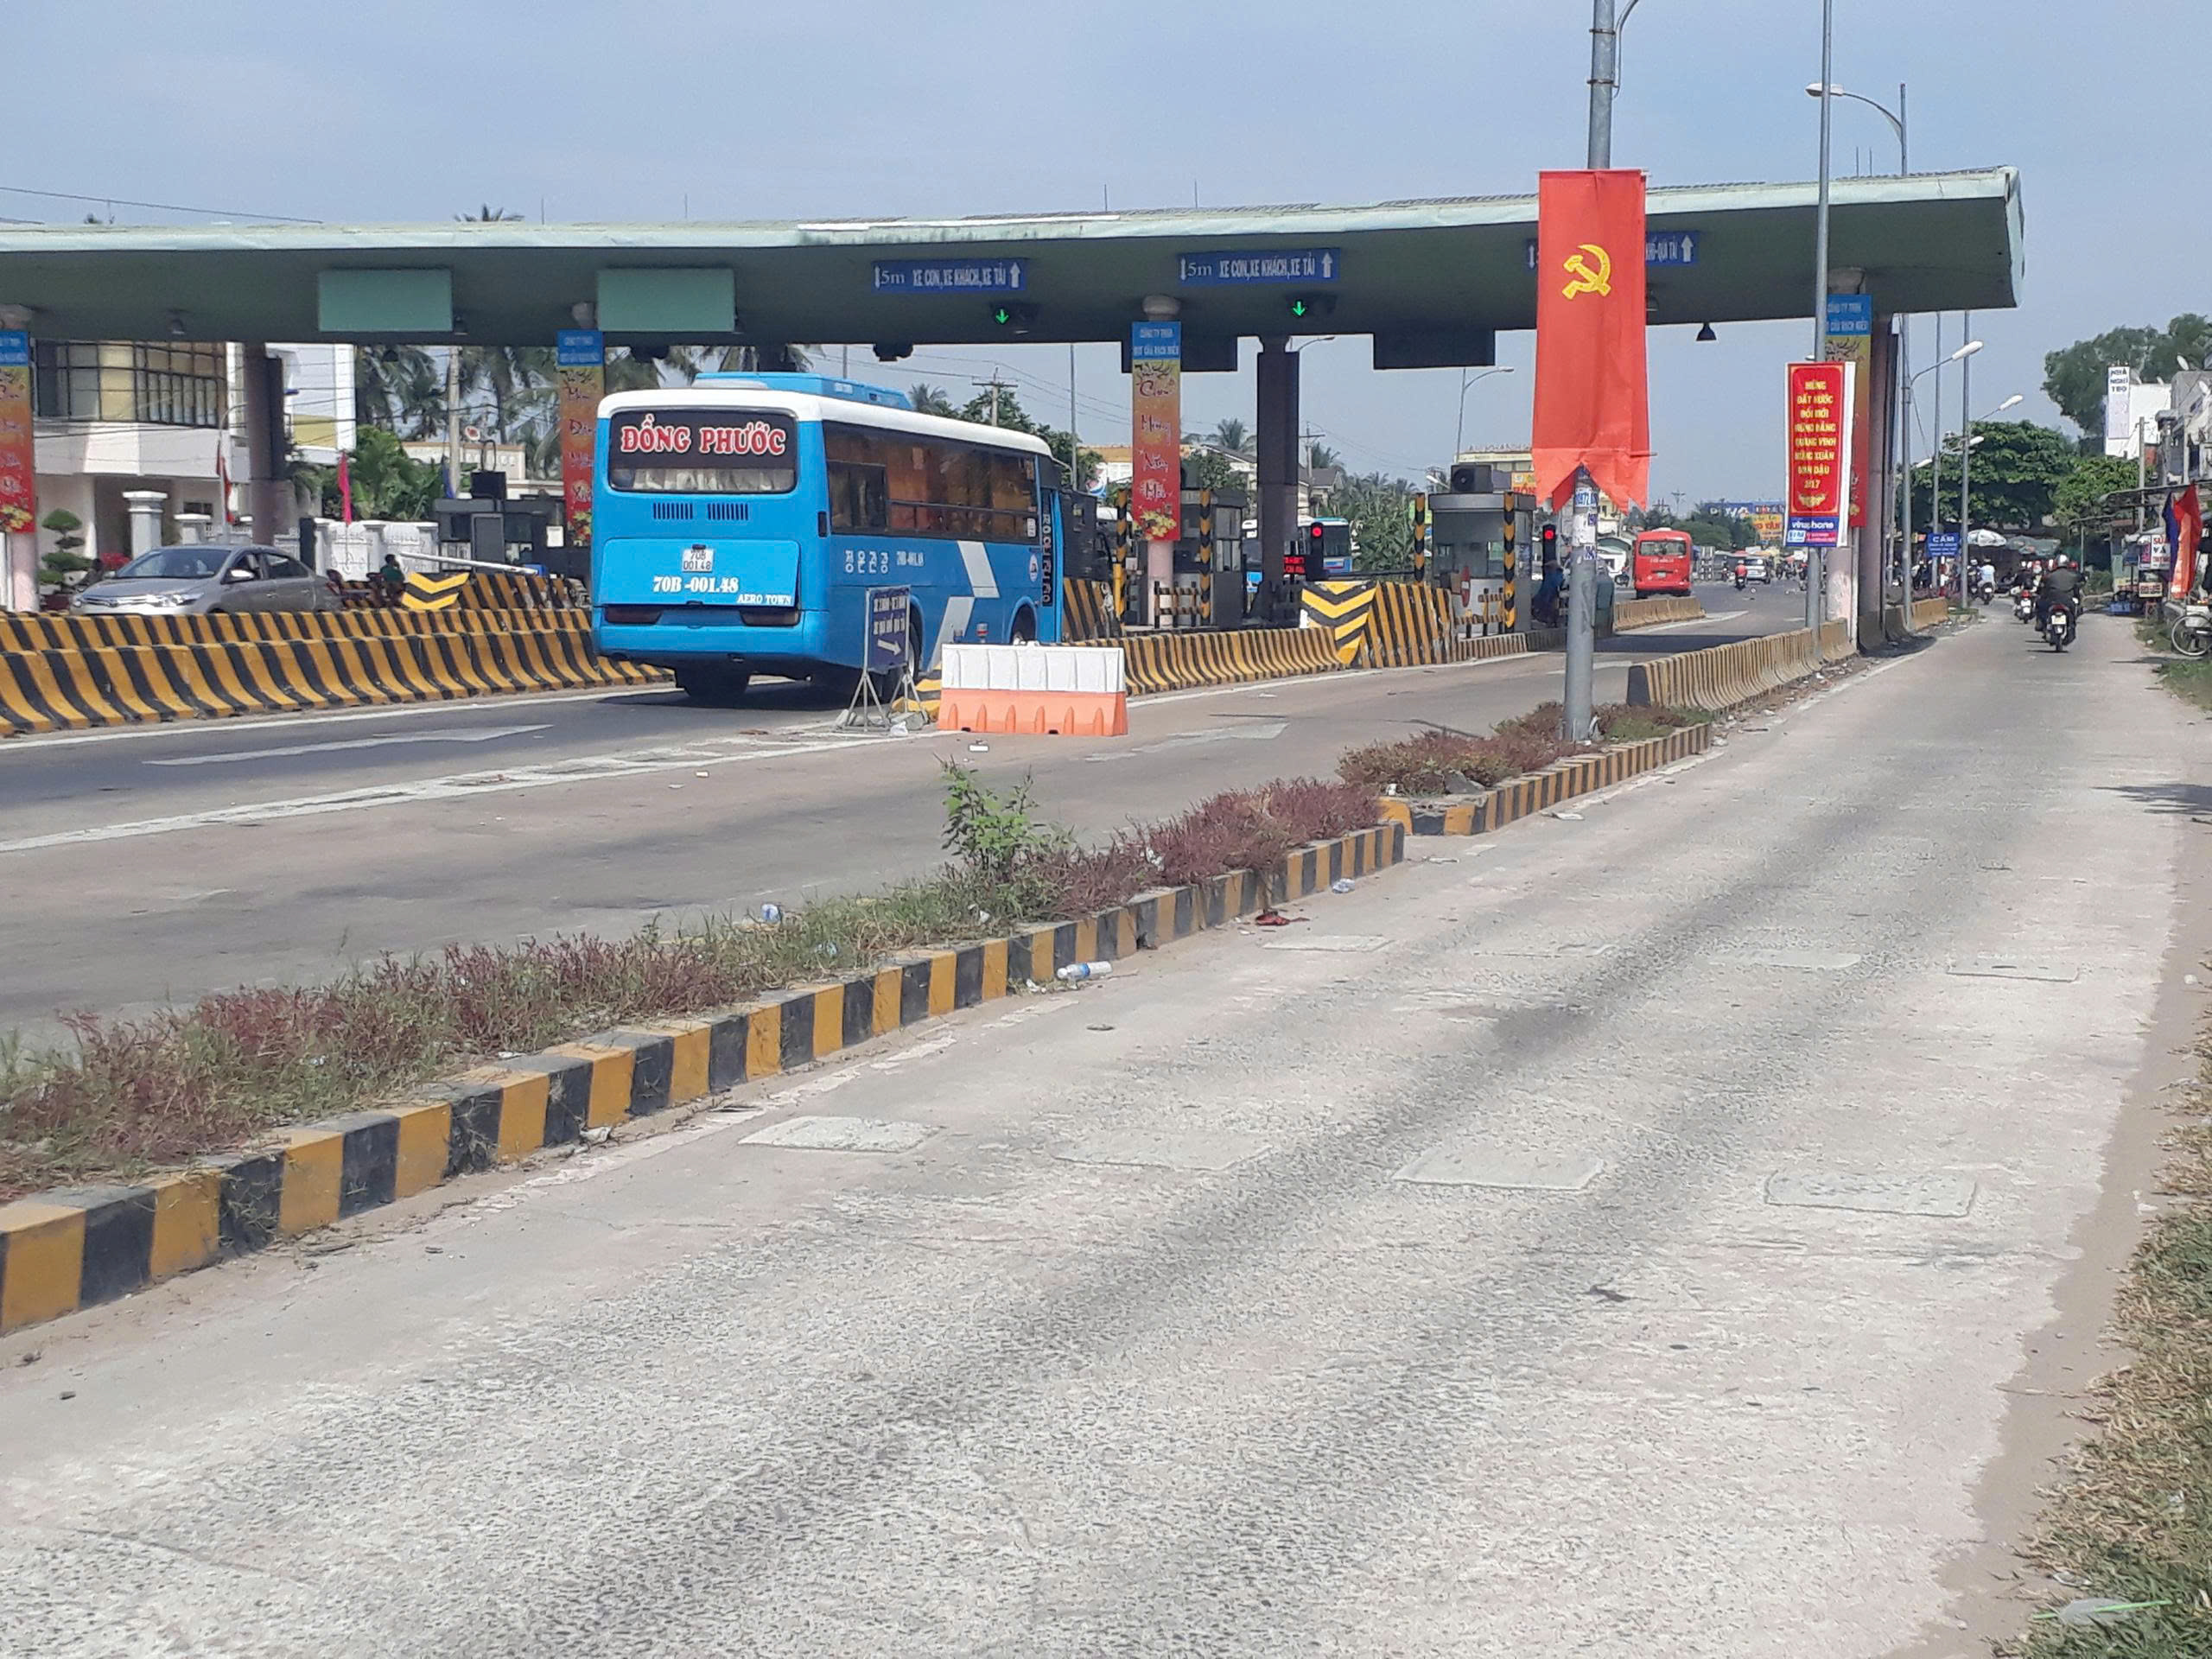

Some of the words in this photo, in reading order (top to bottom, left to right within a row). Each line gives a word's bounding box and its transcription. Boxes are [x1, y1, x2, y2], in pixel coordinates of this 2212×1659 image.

[880, 270, 905, 284] 5m
[1187, 263, 1211, 276] 5m
[1219, 260, 1230, 278] XE
[620, 413, 691, 454] ĐỒNG
[698, 421, 786, 456] PHƯỚC
[683, 561, 712, 571] 001.48
[652, 575, 682, 593] 70B
[736, 594, 763, 605] AERO
[765, 594, 792, 605] TOWN
